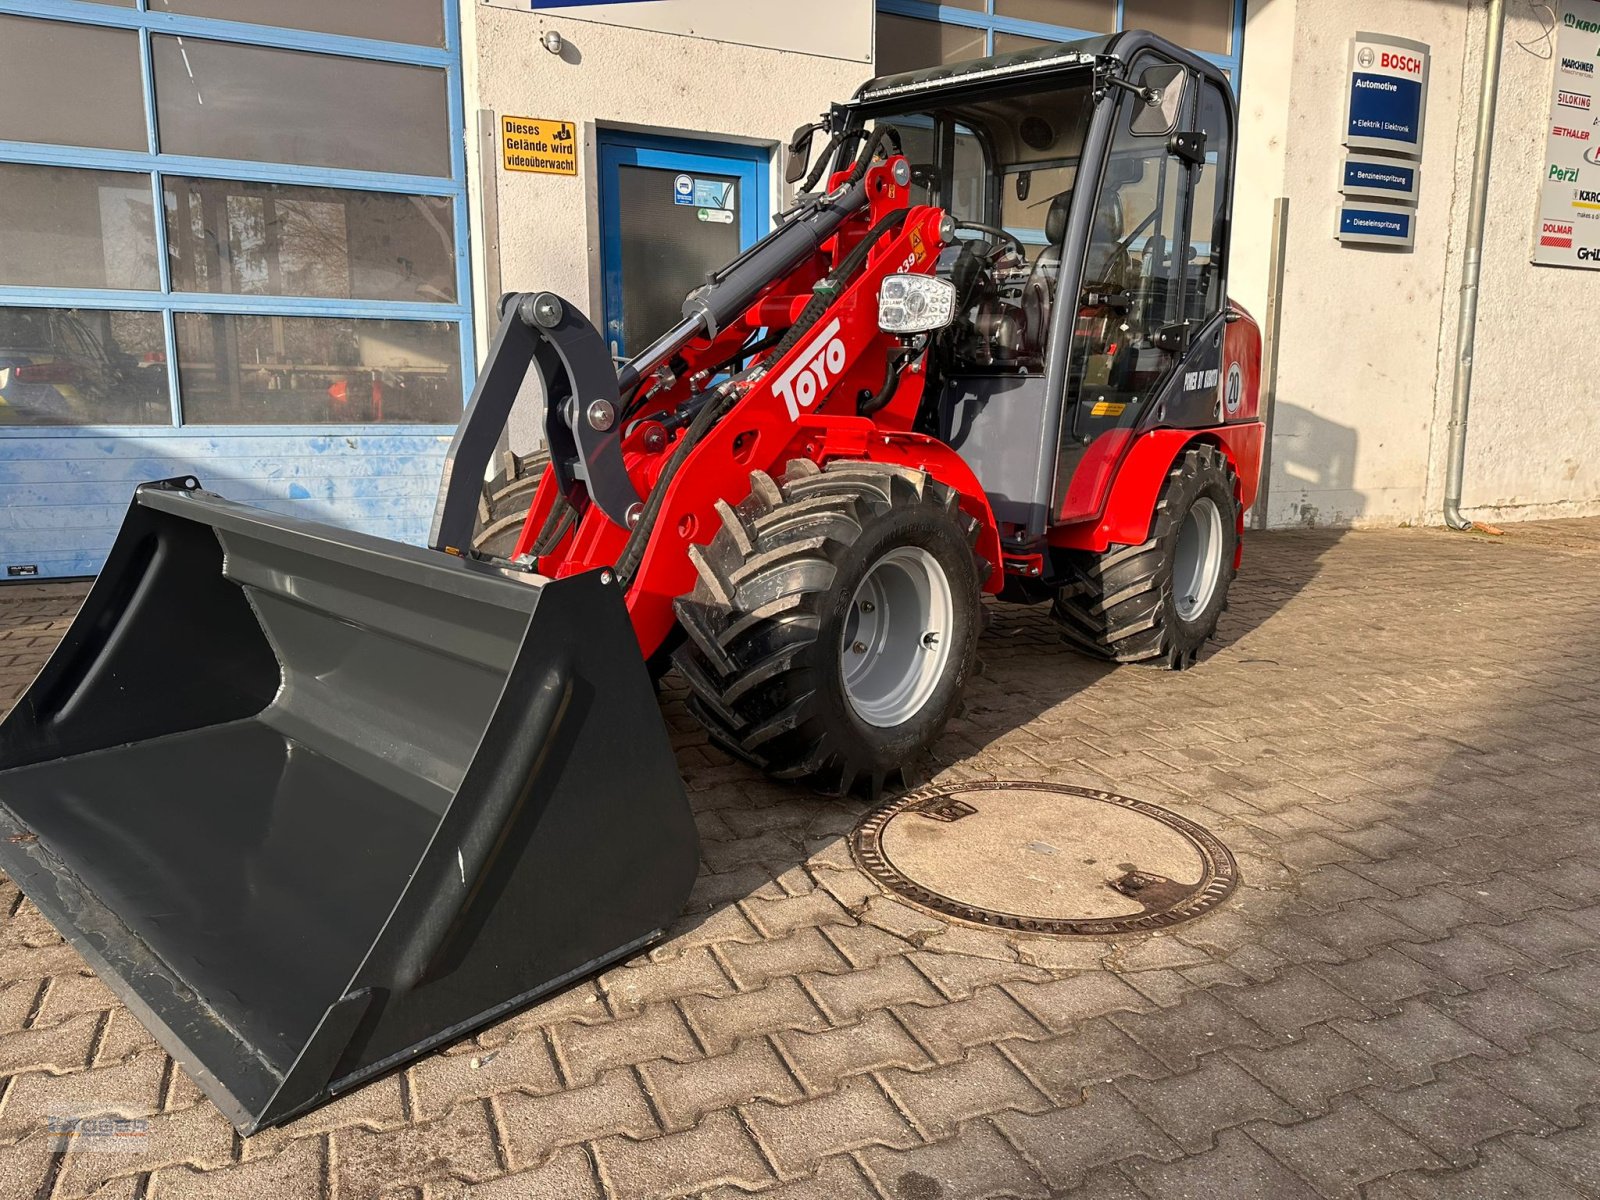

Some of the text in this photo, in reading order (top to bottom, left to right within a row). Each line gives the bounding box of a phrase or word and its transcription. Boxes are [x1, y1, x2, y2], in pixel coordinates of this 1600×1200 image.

[1381, 52, 1421, 74] BOSCH
[1355, 79, 1397, 92] Automotive
[1557, 93, 1591, 108] SILOKING
[505, 121, 540, 136] Dieses
[1357, 119, 1380, 129] Elektrik
[1384, 122, 1409, 133] Elektronik
[1561, 127, 1590, 141] THALER
[506, 138, 573, 155] Gelände wird
[507, 154, 574, 171] videoüberwacht
[1357, 170, 1406, 185] Benzineinspritzung
[1548, 164, 1580, 183] Perzl
[1353, 218, 1401, 231] Dieseleinspritzung
[1543, 223, 1573, 235] DOLMAR
[1227, 372, 1239, 404] 20
